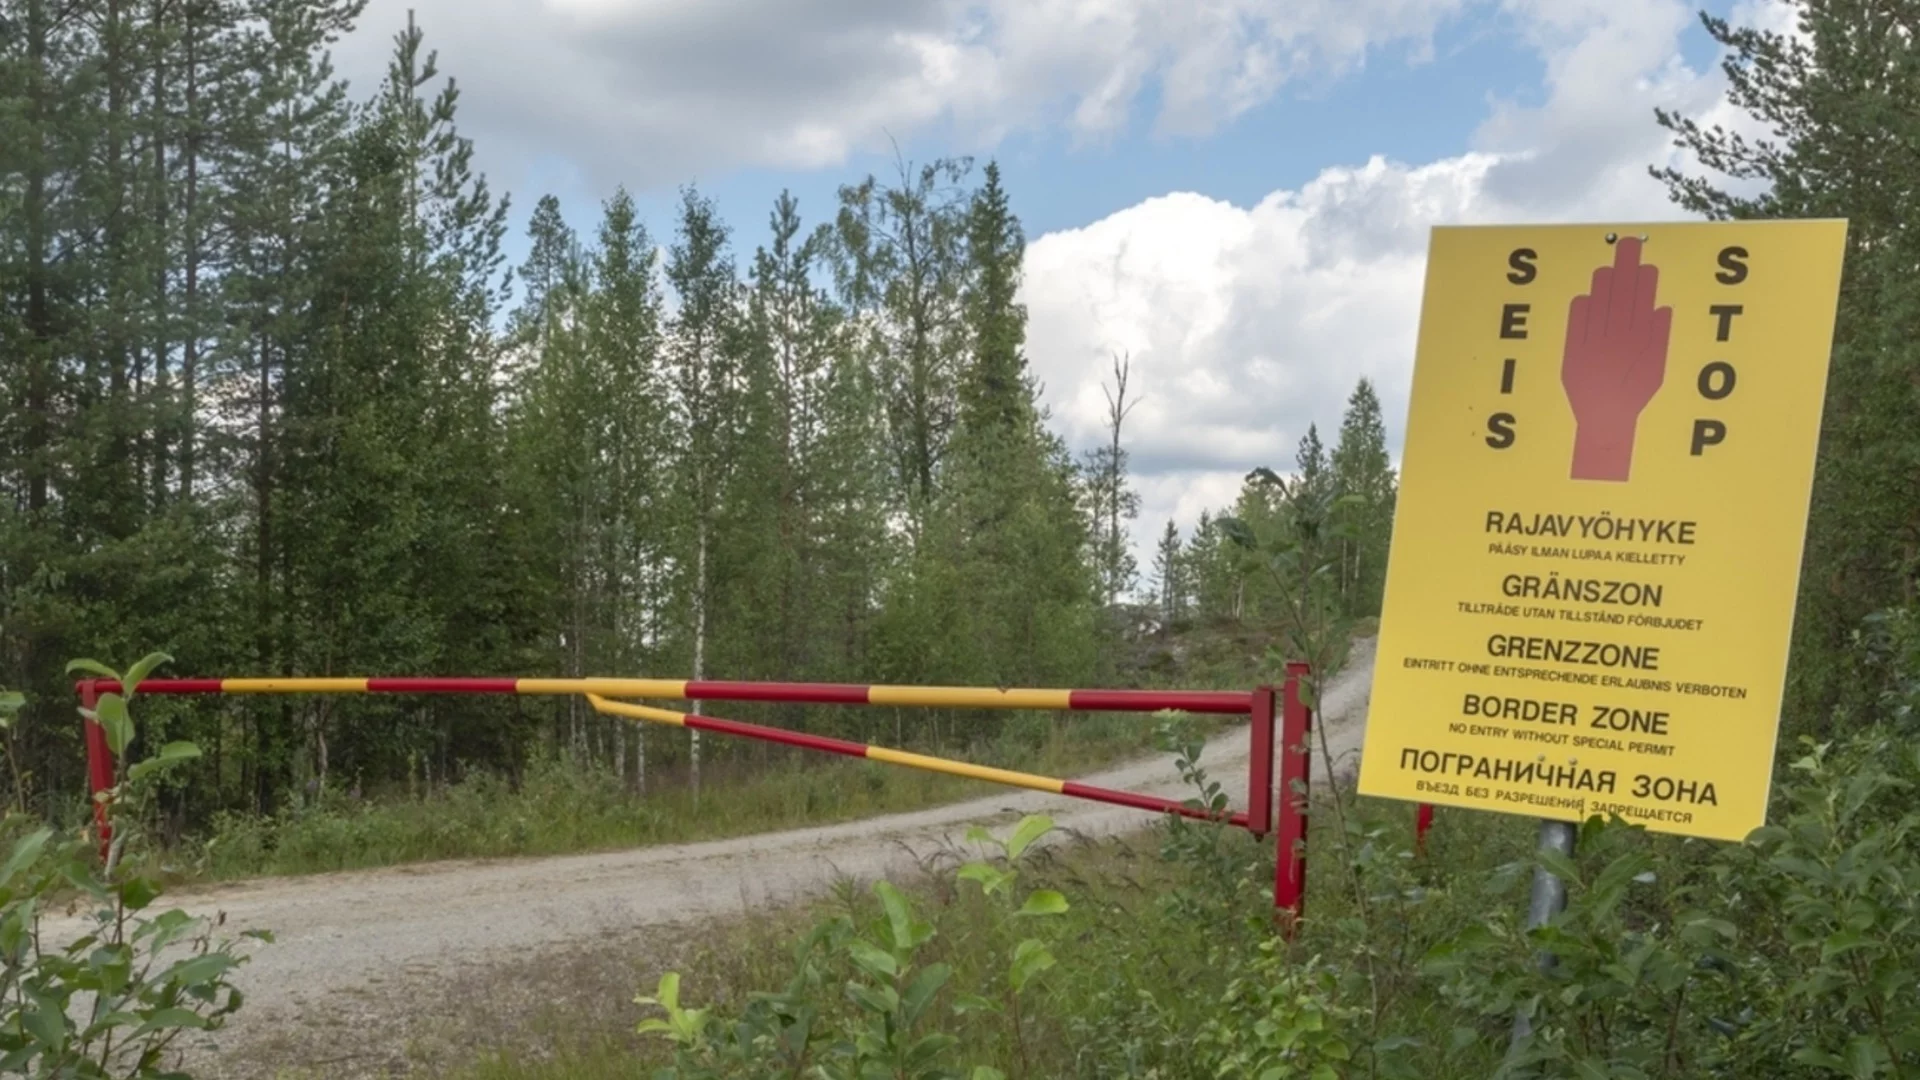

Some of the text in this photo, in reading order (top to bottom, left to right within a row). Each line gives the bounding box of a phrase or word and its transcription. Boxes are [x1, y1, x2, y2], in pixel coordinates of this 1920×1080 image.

[1485, 248, 1538, 449] SEIS
[1690, 246, 1749, 456] STOP
[1485, 510, 1697, 545] RAJAVYÖHYKE
[1530, 545, 1570, 560] ILMAN
[1571, 548, 1613, 562] LUPAA
[1615, 552, 1686, 567] KIELLETTY
[1501, 571, 1664, 608] GRÄNSZON
[1522, 606, 1556, 620] UTAN
[1558, 608, 1625, 625] TILLSTÅND
[1626, 613, 1704, 631] FÖRBJUDET
[1486, 633, 1661, 671] GRENZZONE
[1402, 656, 1748, 700] EINTRITT OHNE ENTSPRECHENDE ERLAUBNIS VERBOTEN
[1462, 693, 1671, 736] BORDER ZONE
[1448, 722, 1676, 757] NO ENTRY WITHOUT SPECIAL PERMIT
[1399, 747, 1718, 807] ПОГРАНИЧНАЯ ЗОНА
[1416, 779, 1460, 797] ВЪЕЗД
[1465, 785, 1490, 799] БЕЗ
[1494, 789, 1585, 811] РАЗРЕШЕНИЯ
